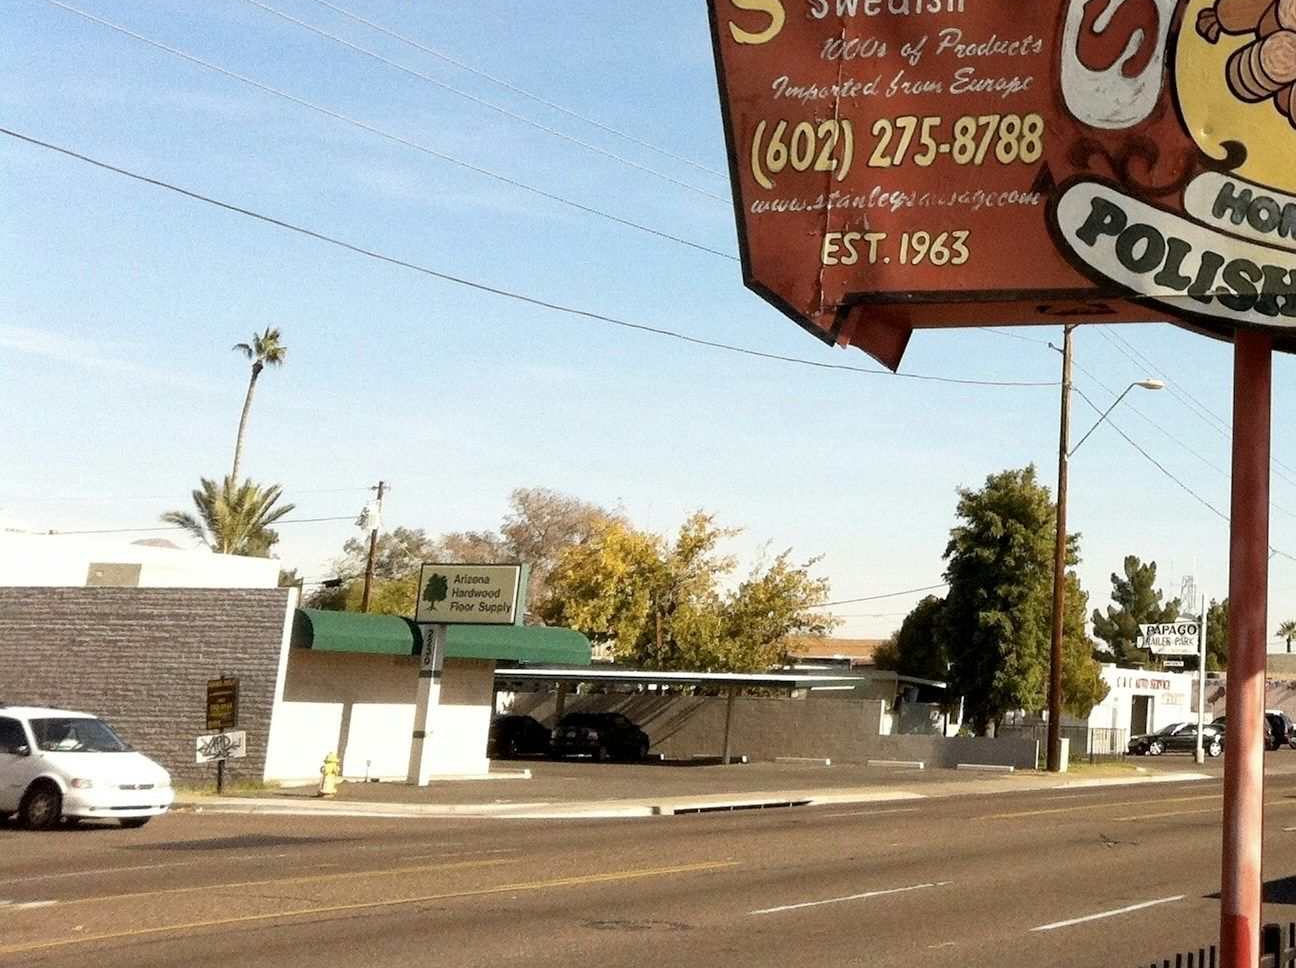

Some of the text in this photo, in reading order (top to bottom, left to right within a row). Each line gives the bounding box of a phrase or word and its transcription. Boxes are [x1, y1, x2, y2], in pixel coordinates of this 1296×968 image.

[899, 35, 928, 65] of
[936, 28, 1043, 56] Products
[771, 68, 1035, 107] Imported from Europe
[750, 113, 1046, 192] (602) 275-8788
[820, 229, 970, 267] EST. 1963
[454, 575, 490, 585] Arizona
[452, 589, 500, 599] Hardwood
[450, 602, 512, 612] Floor Supply
[1146, 624, 1197, 636] PAPAGO
